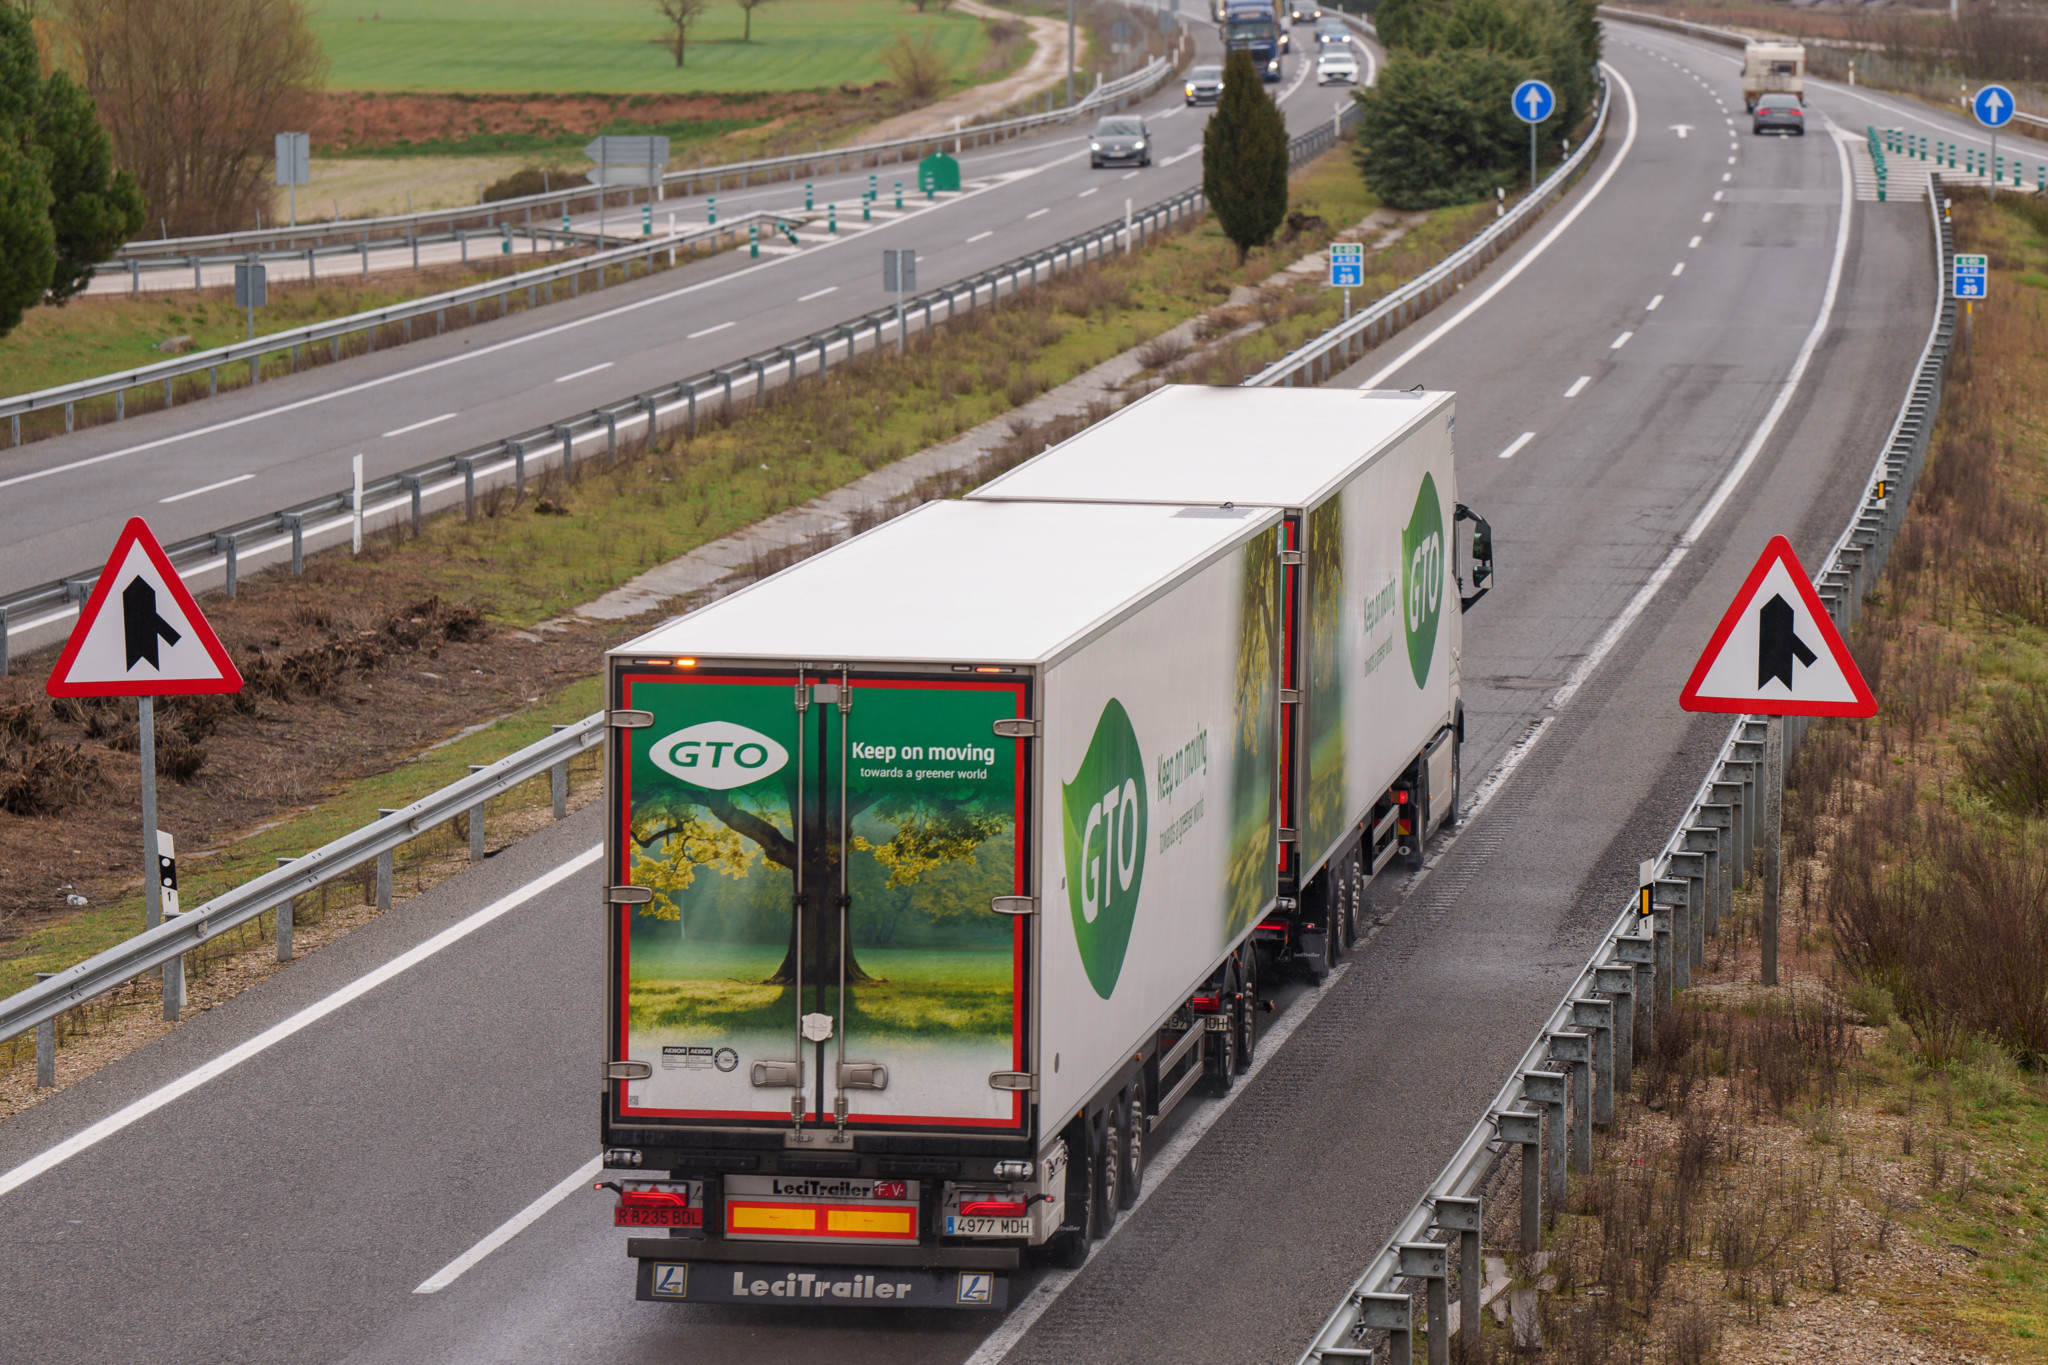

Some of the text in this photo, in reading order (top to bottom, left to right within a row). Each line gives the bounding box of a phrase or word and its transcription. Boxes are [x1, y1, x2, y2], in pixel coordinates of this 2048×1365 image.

[1339, 273, 1355, 284] 39
[1962, 284, 1978, 295] 39
[1409, 531, 1440, 633] GTO
[668, 741, 769, 768] GTO
[852, 742, 995, 765] Keep on moving
[1157, 721, 1207, 805] Keep on moving
[860, 767, 987, 780] towards a greener world
[1081, 778, 1138, 924] GTO
[167, 891, 171, 901] 1
[1643, 919, 1648, 929] 1
[773, 1179, 871, 1197] LeciTrailer
[619, 1209, 627, 1223] R
[631, 1210, 669, 1224] 8235
[957, 1218, 1029, 1234] 4977 MDH
[732, 1271, 912, 1299] LeciTrailer
